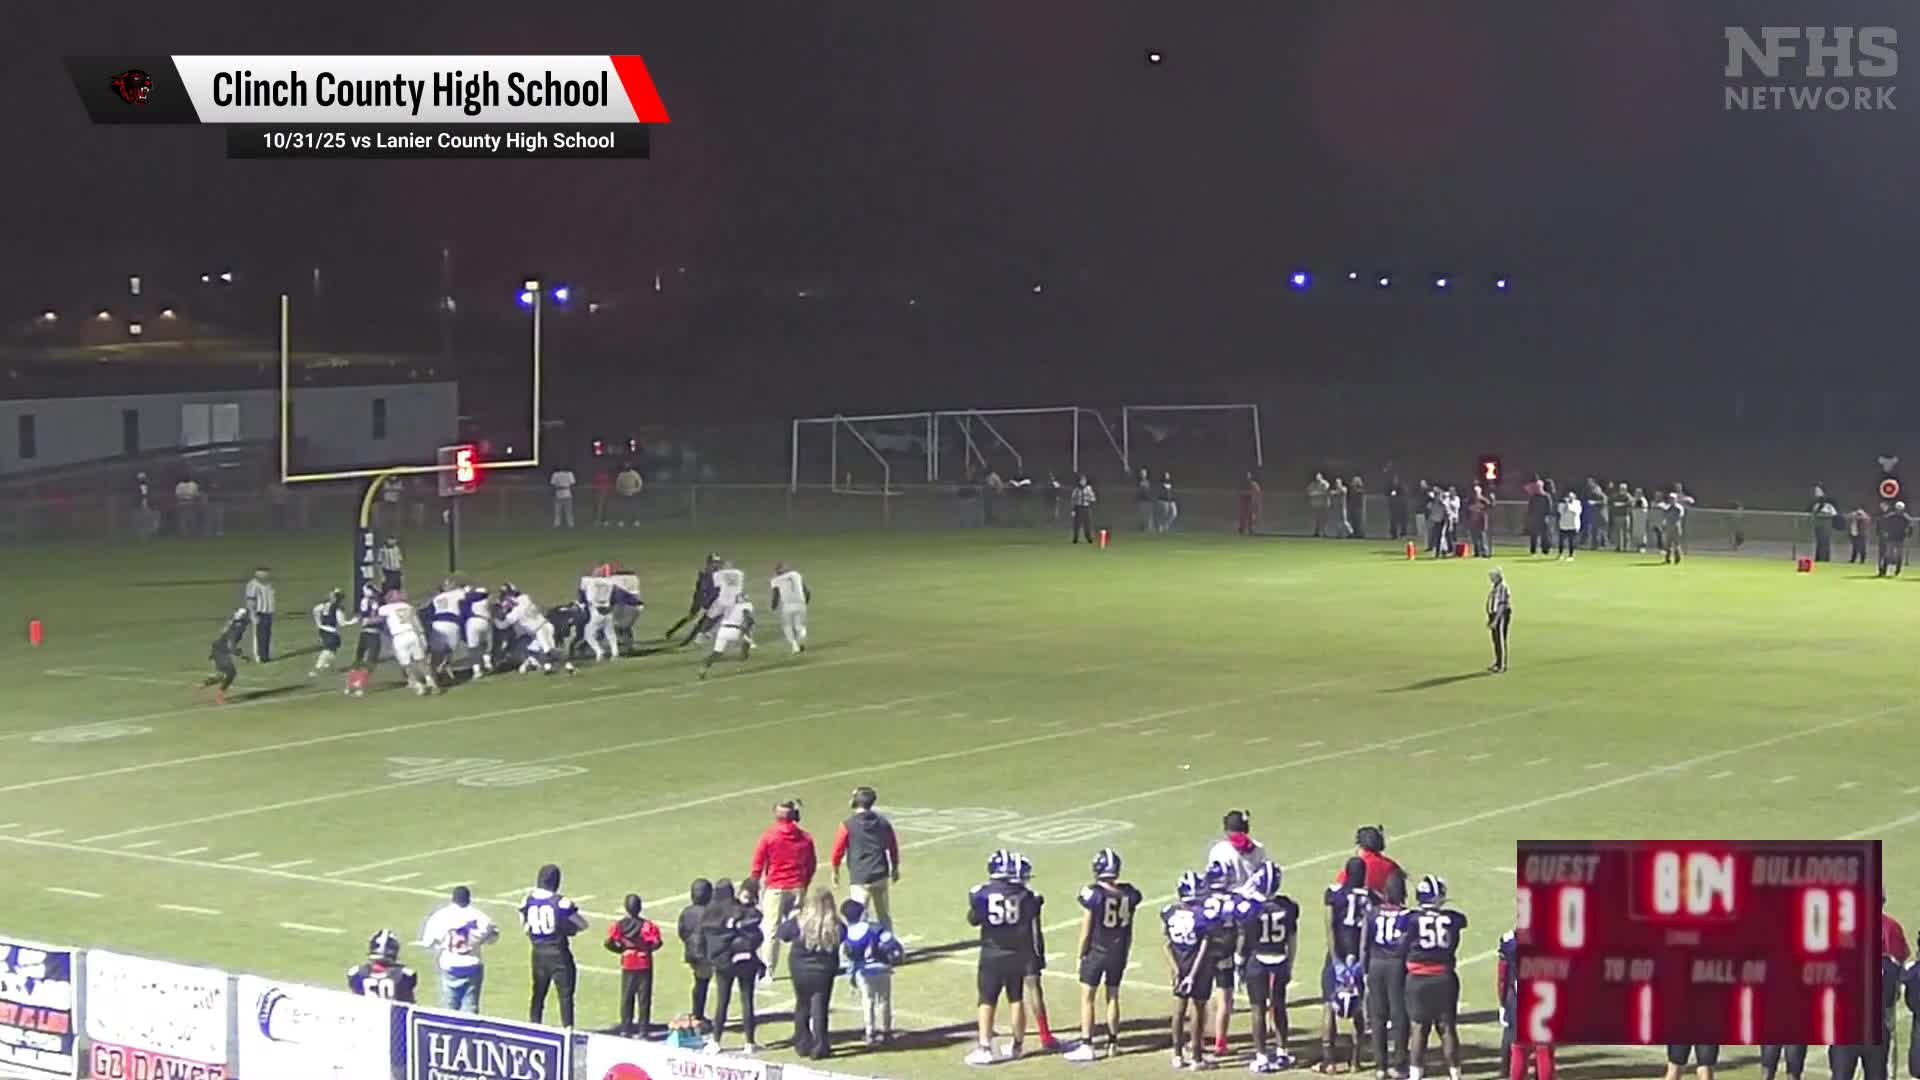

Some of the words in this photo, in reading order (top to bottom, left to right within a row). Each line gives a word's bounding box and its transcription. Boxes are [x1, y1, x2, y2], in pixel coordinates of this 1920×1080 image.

[1752, 856, 1859, 885] BULLDOGS
[527, 905, 555, 934] 40
[988, 893, 1020, 924] 58
[1104, 896, 1130, 927] 64
[1259, 910, 1287, 943] 15
[1559, 886, 1586, 949] 0
[1803, 889, 1831, 953] 0
[1418, 916, 1451, 949] 56
[1691, 960, 1736, 984] BALL
[1529, 981, 1557, 1043] 2
[1640, 985, 1652, 1045] 1
[1740, 986, 1753, 1045] 1
[1823, 986, 1836, 1045] 1
[428, 1032, 546, 1080] HAINES
